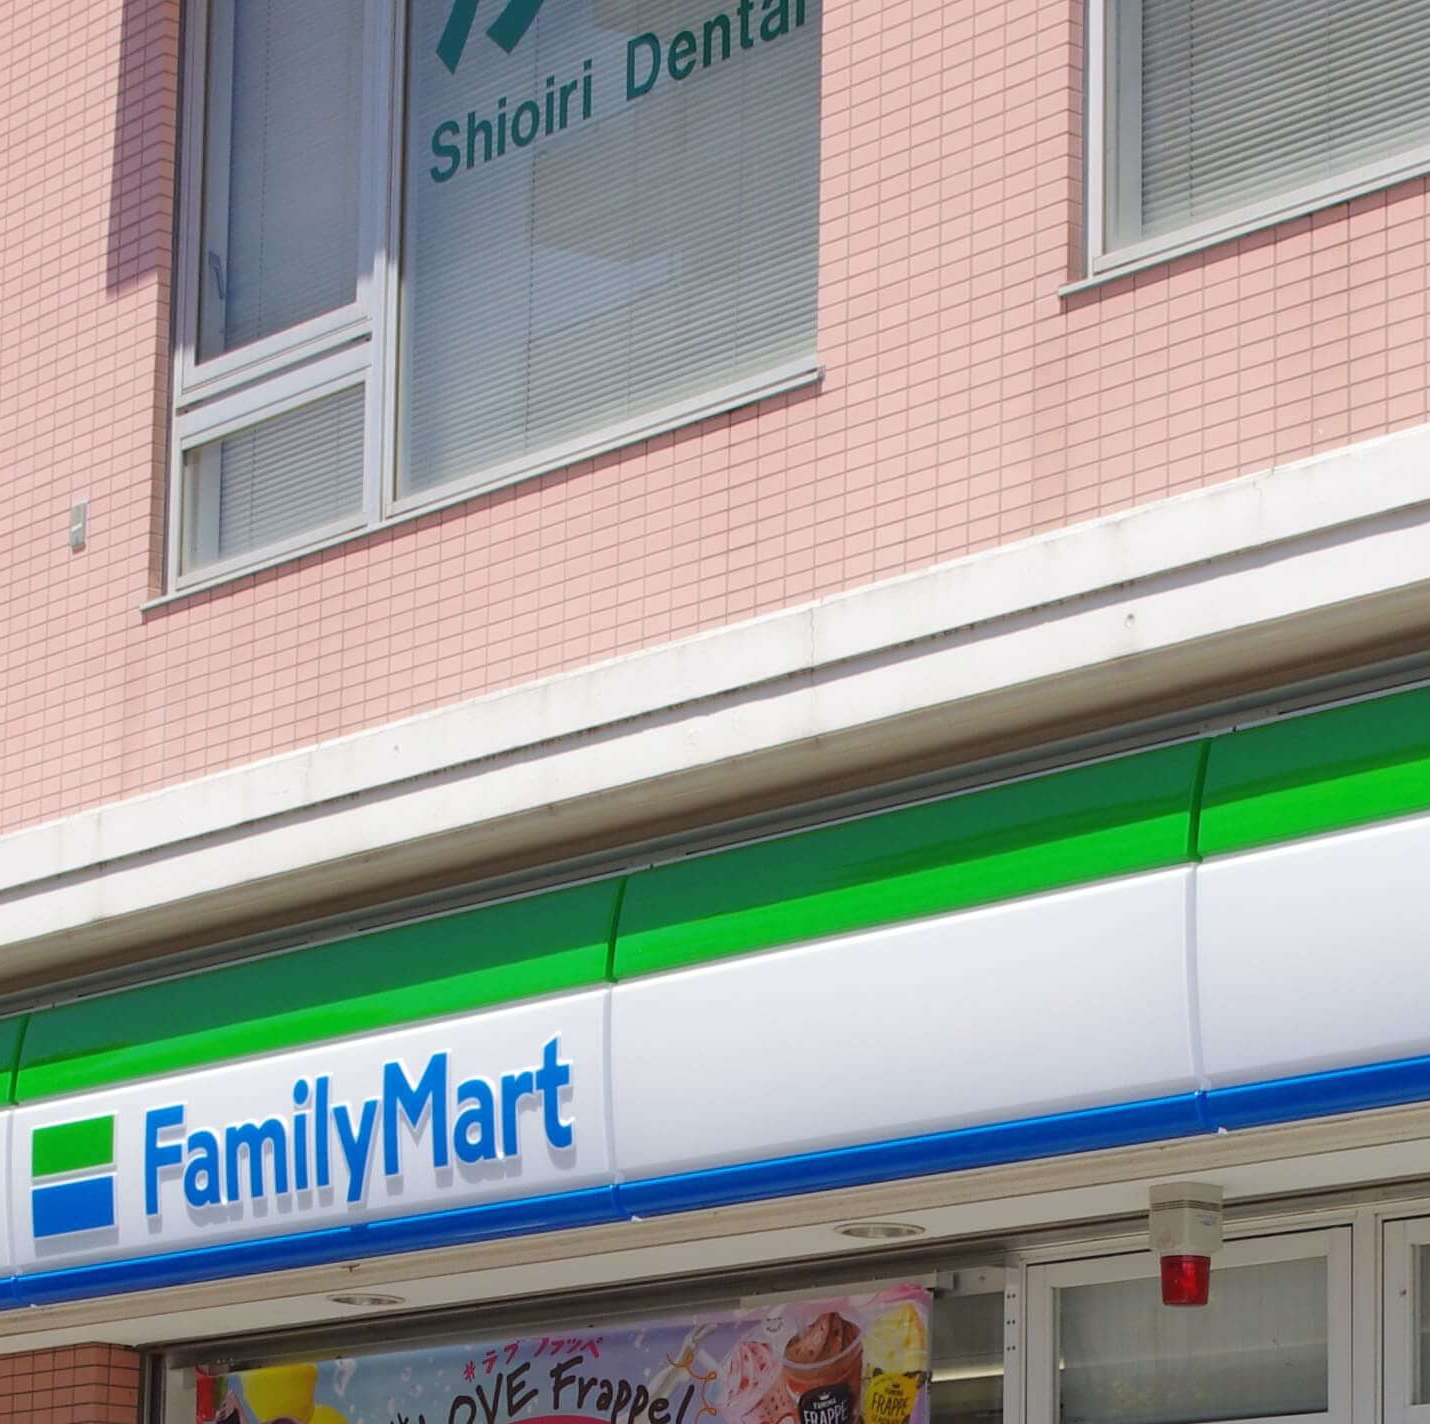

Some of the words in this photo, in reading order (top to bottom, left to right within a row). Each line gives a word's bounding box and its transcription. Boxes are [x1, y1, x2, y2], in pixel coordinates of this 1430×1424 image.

[429, 58, 593, 183] Shioiri
[627, 0, 806, 101] Dental
[144, 1034, 575, 1217] FamilyMart
